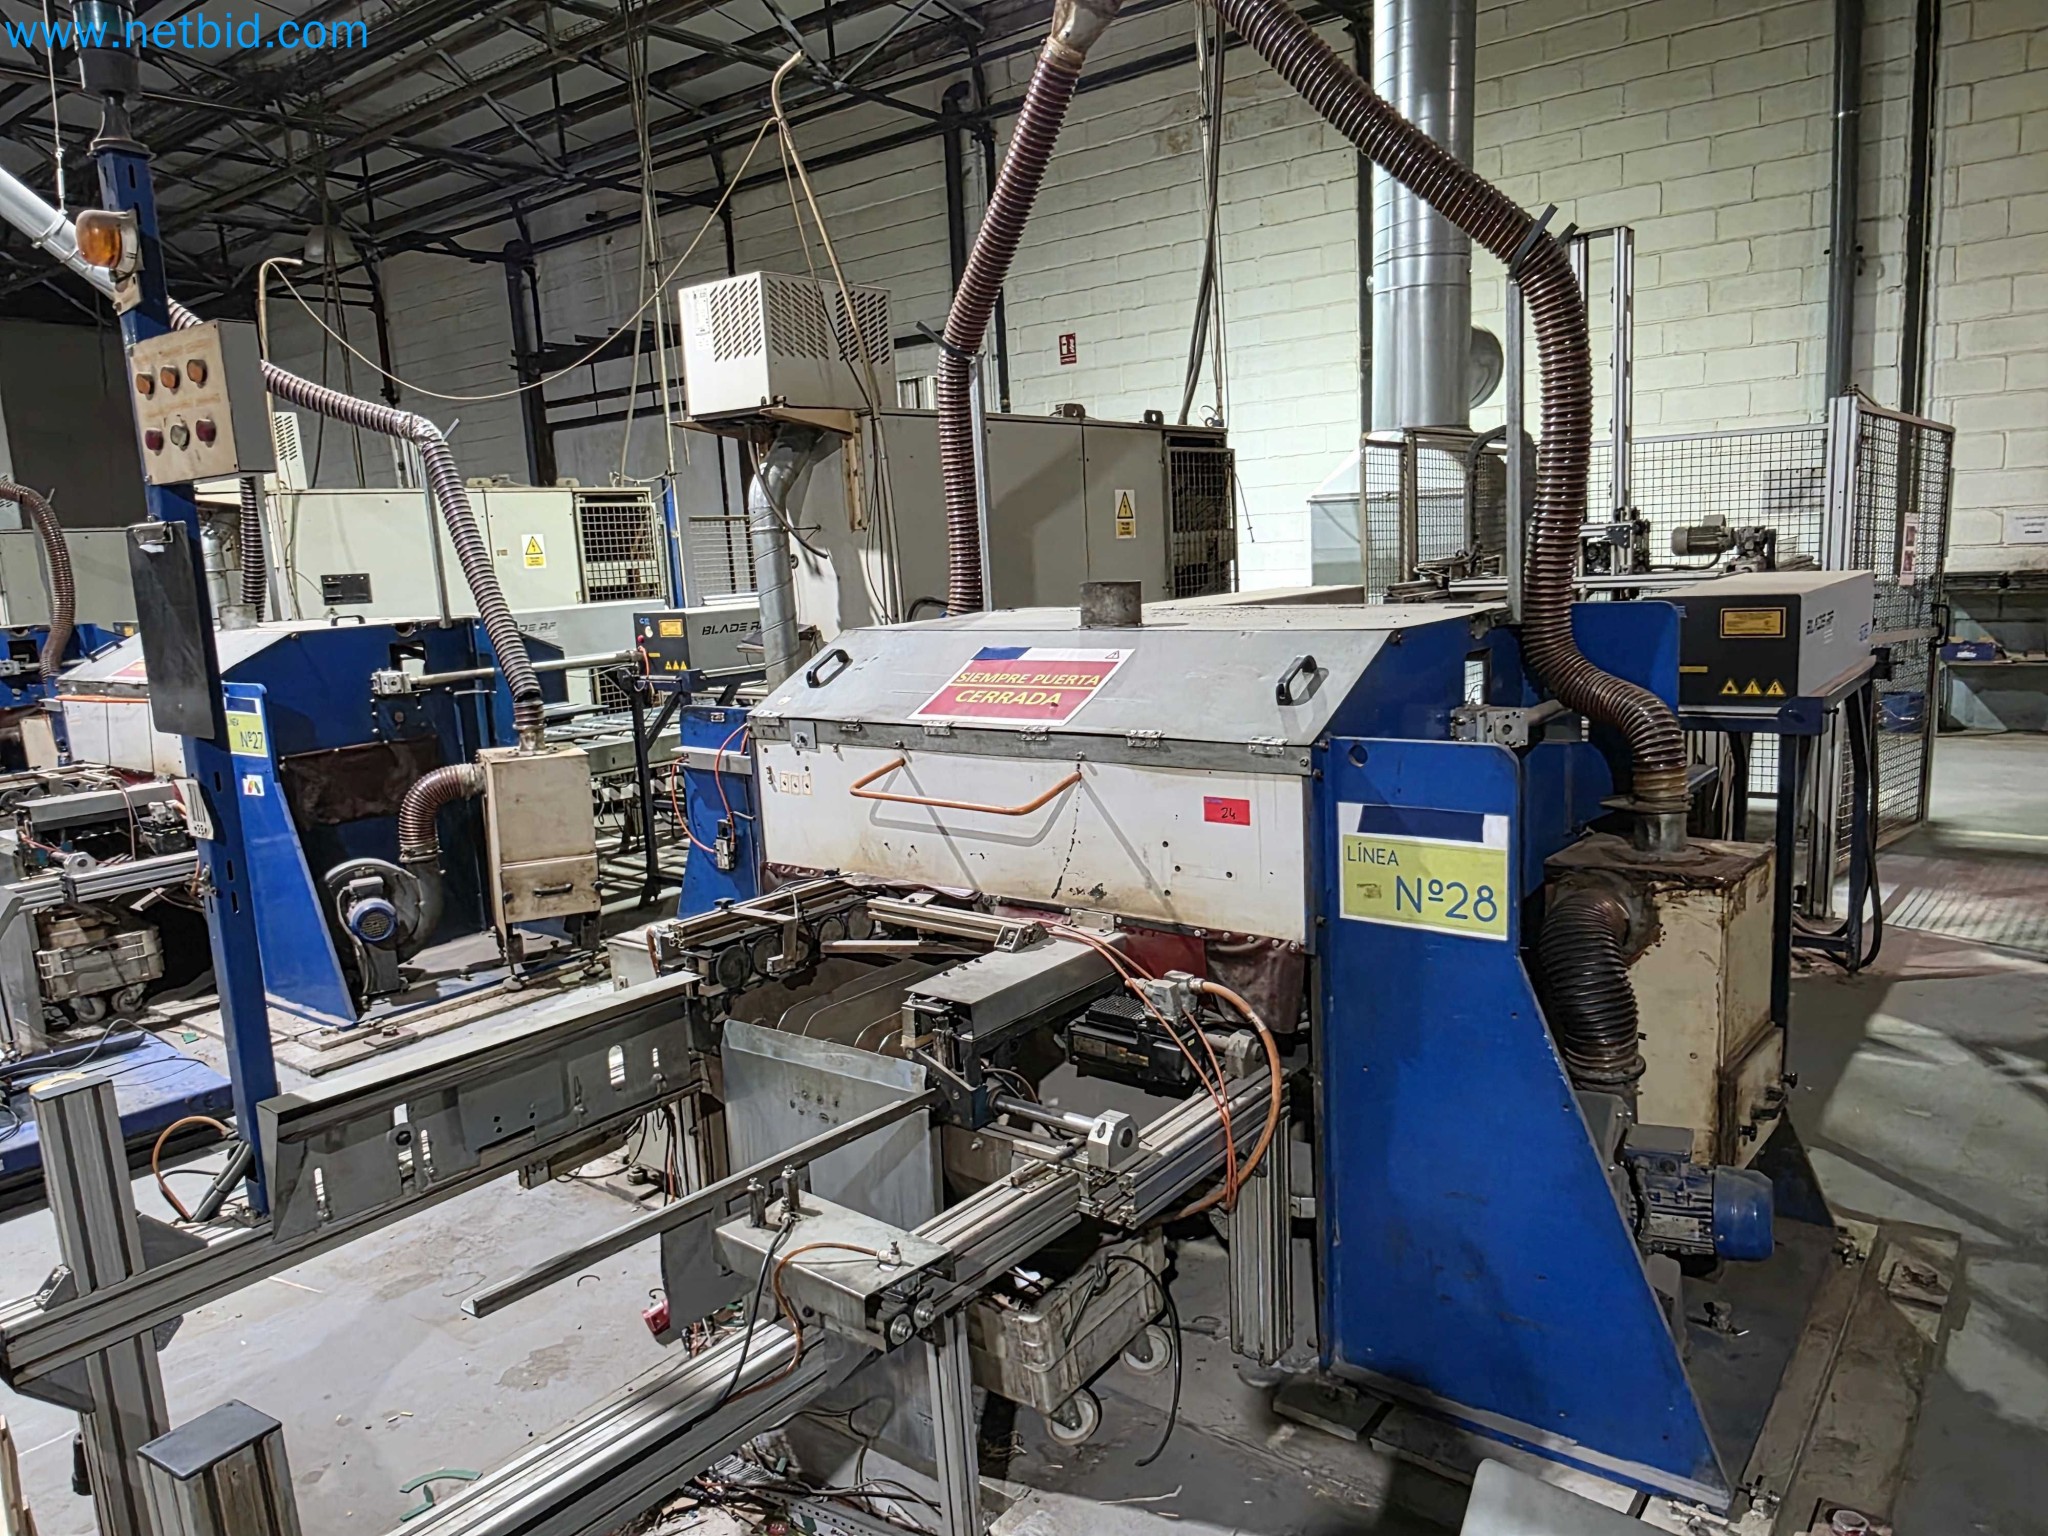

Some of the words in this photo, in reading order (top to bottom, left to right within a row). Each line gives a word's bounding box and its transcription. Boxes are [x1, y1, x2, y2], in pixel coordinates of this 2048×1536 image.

[702, 622, 748, 636] BLADE
[955, 672, 1030, 684] SIEMPRE
[1030, 674, 1100, 686] PUERTA
[955, 690, 1062, 706] CERRADA
[1220, 807, 1236, 820] 24
[1347, 842, 1399, 866] LÍNEA
[1395, 875, 1498, 923] Nº28
